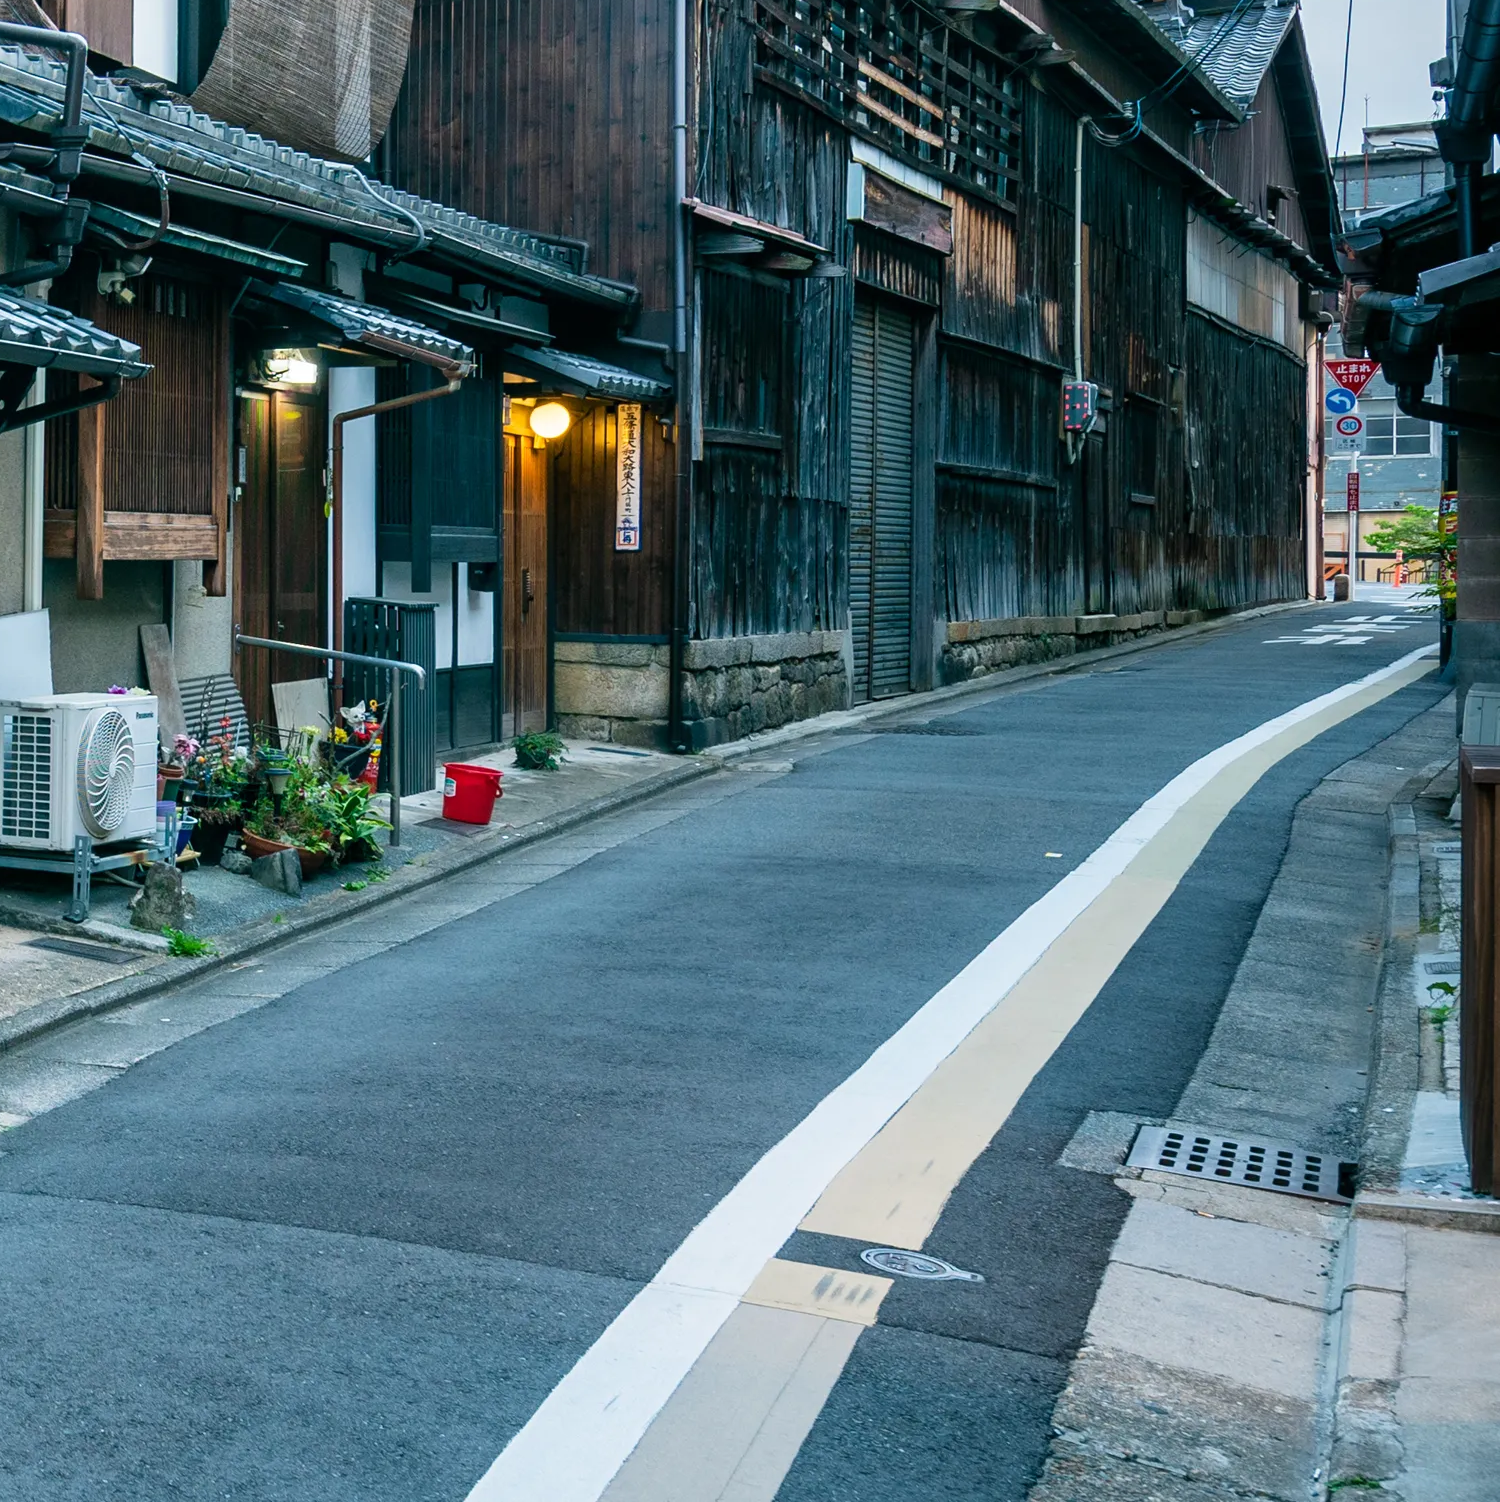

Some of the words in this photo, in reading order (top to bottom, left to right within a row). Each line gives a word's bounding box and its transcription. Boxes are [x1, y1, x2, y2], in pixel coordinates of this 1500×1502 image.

[1336, 363, 1372, 374] 止まれ
[1341, 374, 1366, 383] STOP
[1342, 421, 1357, 430] 30
